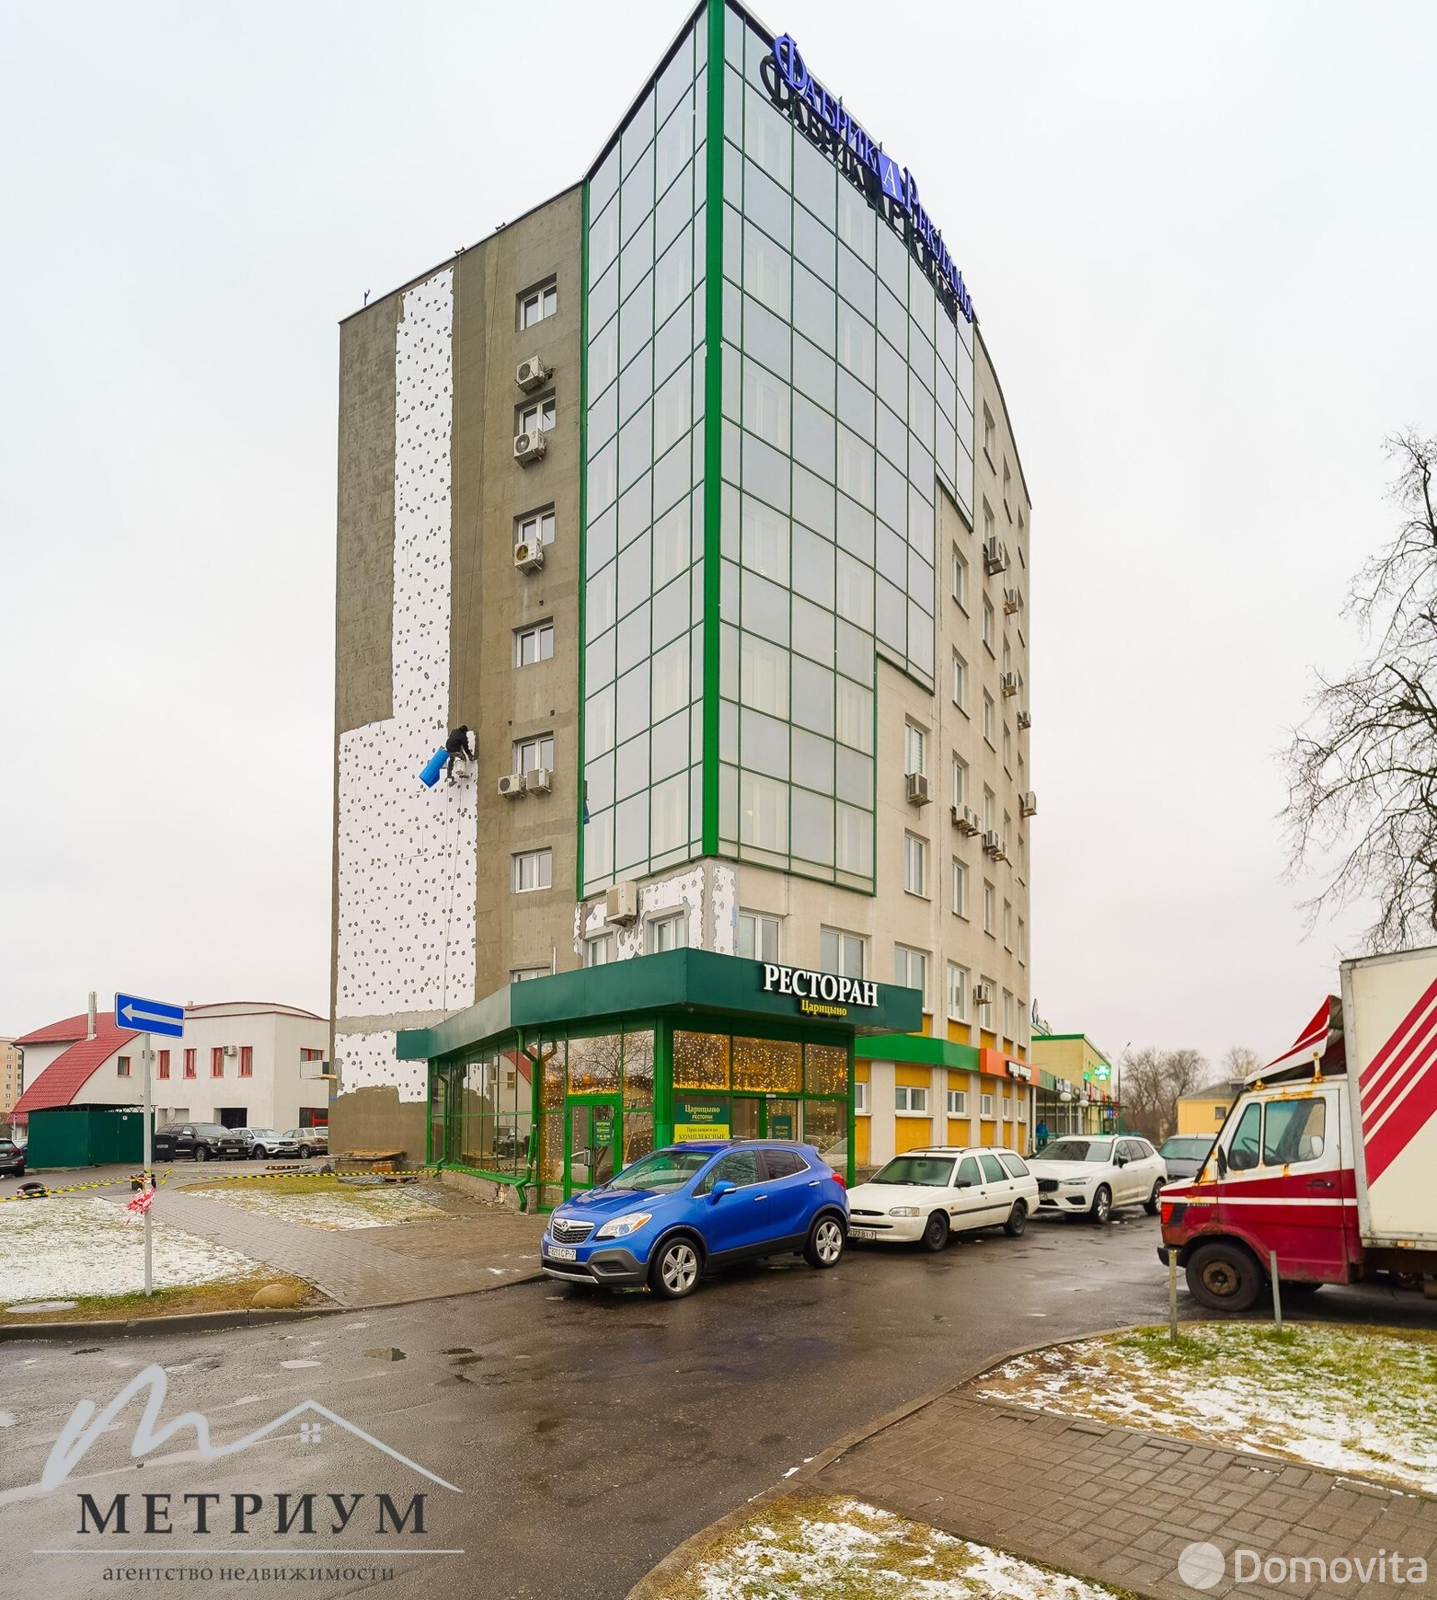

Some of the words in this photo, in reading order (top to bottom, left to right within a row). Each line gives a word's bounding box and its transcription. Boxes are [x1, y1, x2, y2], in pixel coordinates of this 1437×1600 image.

[763, 963, 879, 1007] РЕСТОРАН
[801, 999, 848, 1017] Царицыно
[685, 1105, 720, 1114] Царицыно
